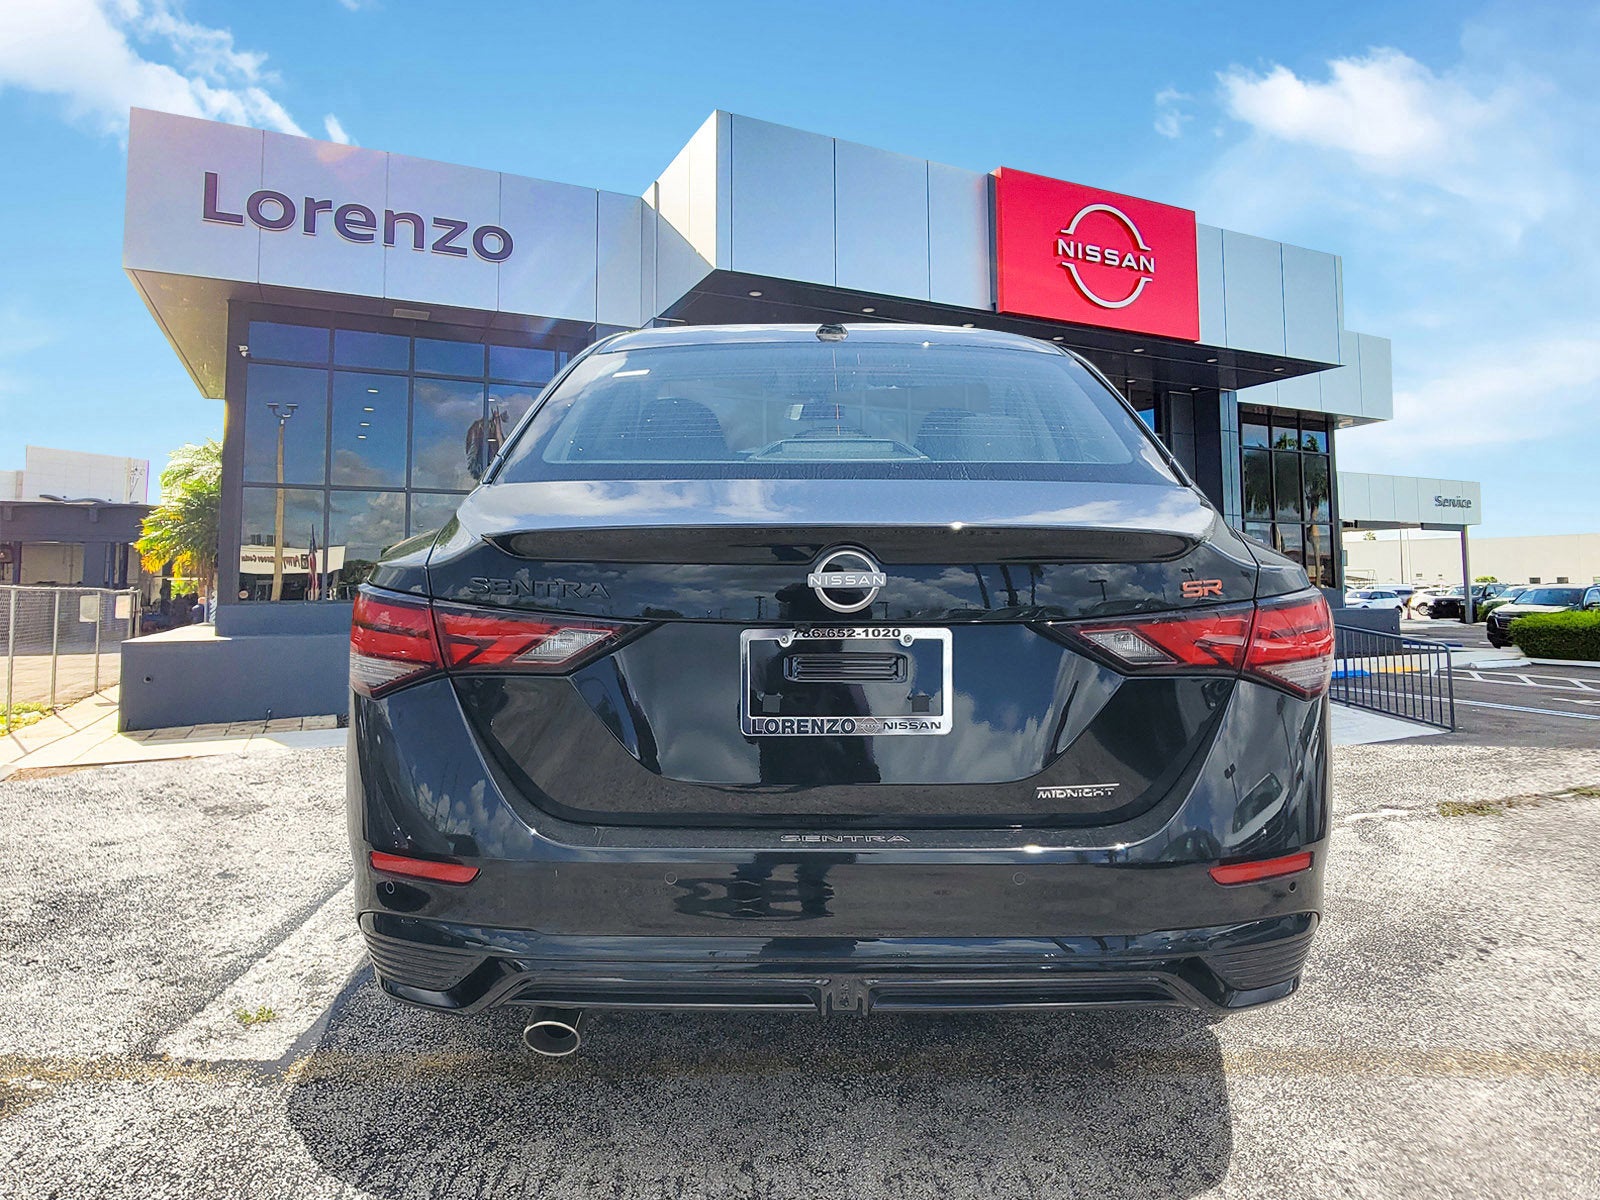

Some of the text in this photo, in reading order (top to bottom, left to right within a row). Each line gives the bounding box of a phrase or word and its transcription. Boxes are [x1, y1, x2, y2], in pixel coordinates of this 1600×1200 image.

[202, 171, 514, 262] Lorenzo
[1056, 238, 1155, 273] NISSAN
[1434, 495, 1472, 508] Service
[469, 576, 610, 599] SENTRA
[810, 575, 886, 586] NISSAN
[1182, 579, 1223, 598] SR
[792, 628, 901, 638] 786-652-1020
[751, 718, 856, 734] LORENZO
[883, 721, 941, 730] NISSAN
[1037, 787, 1115, 799] MIDNIGHT
[780, 834, 911, 843] SENTRA
